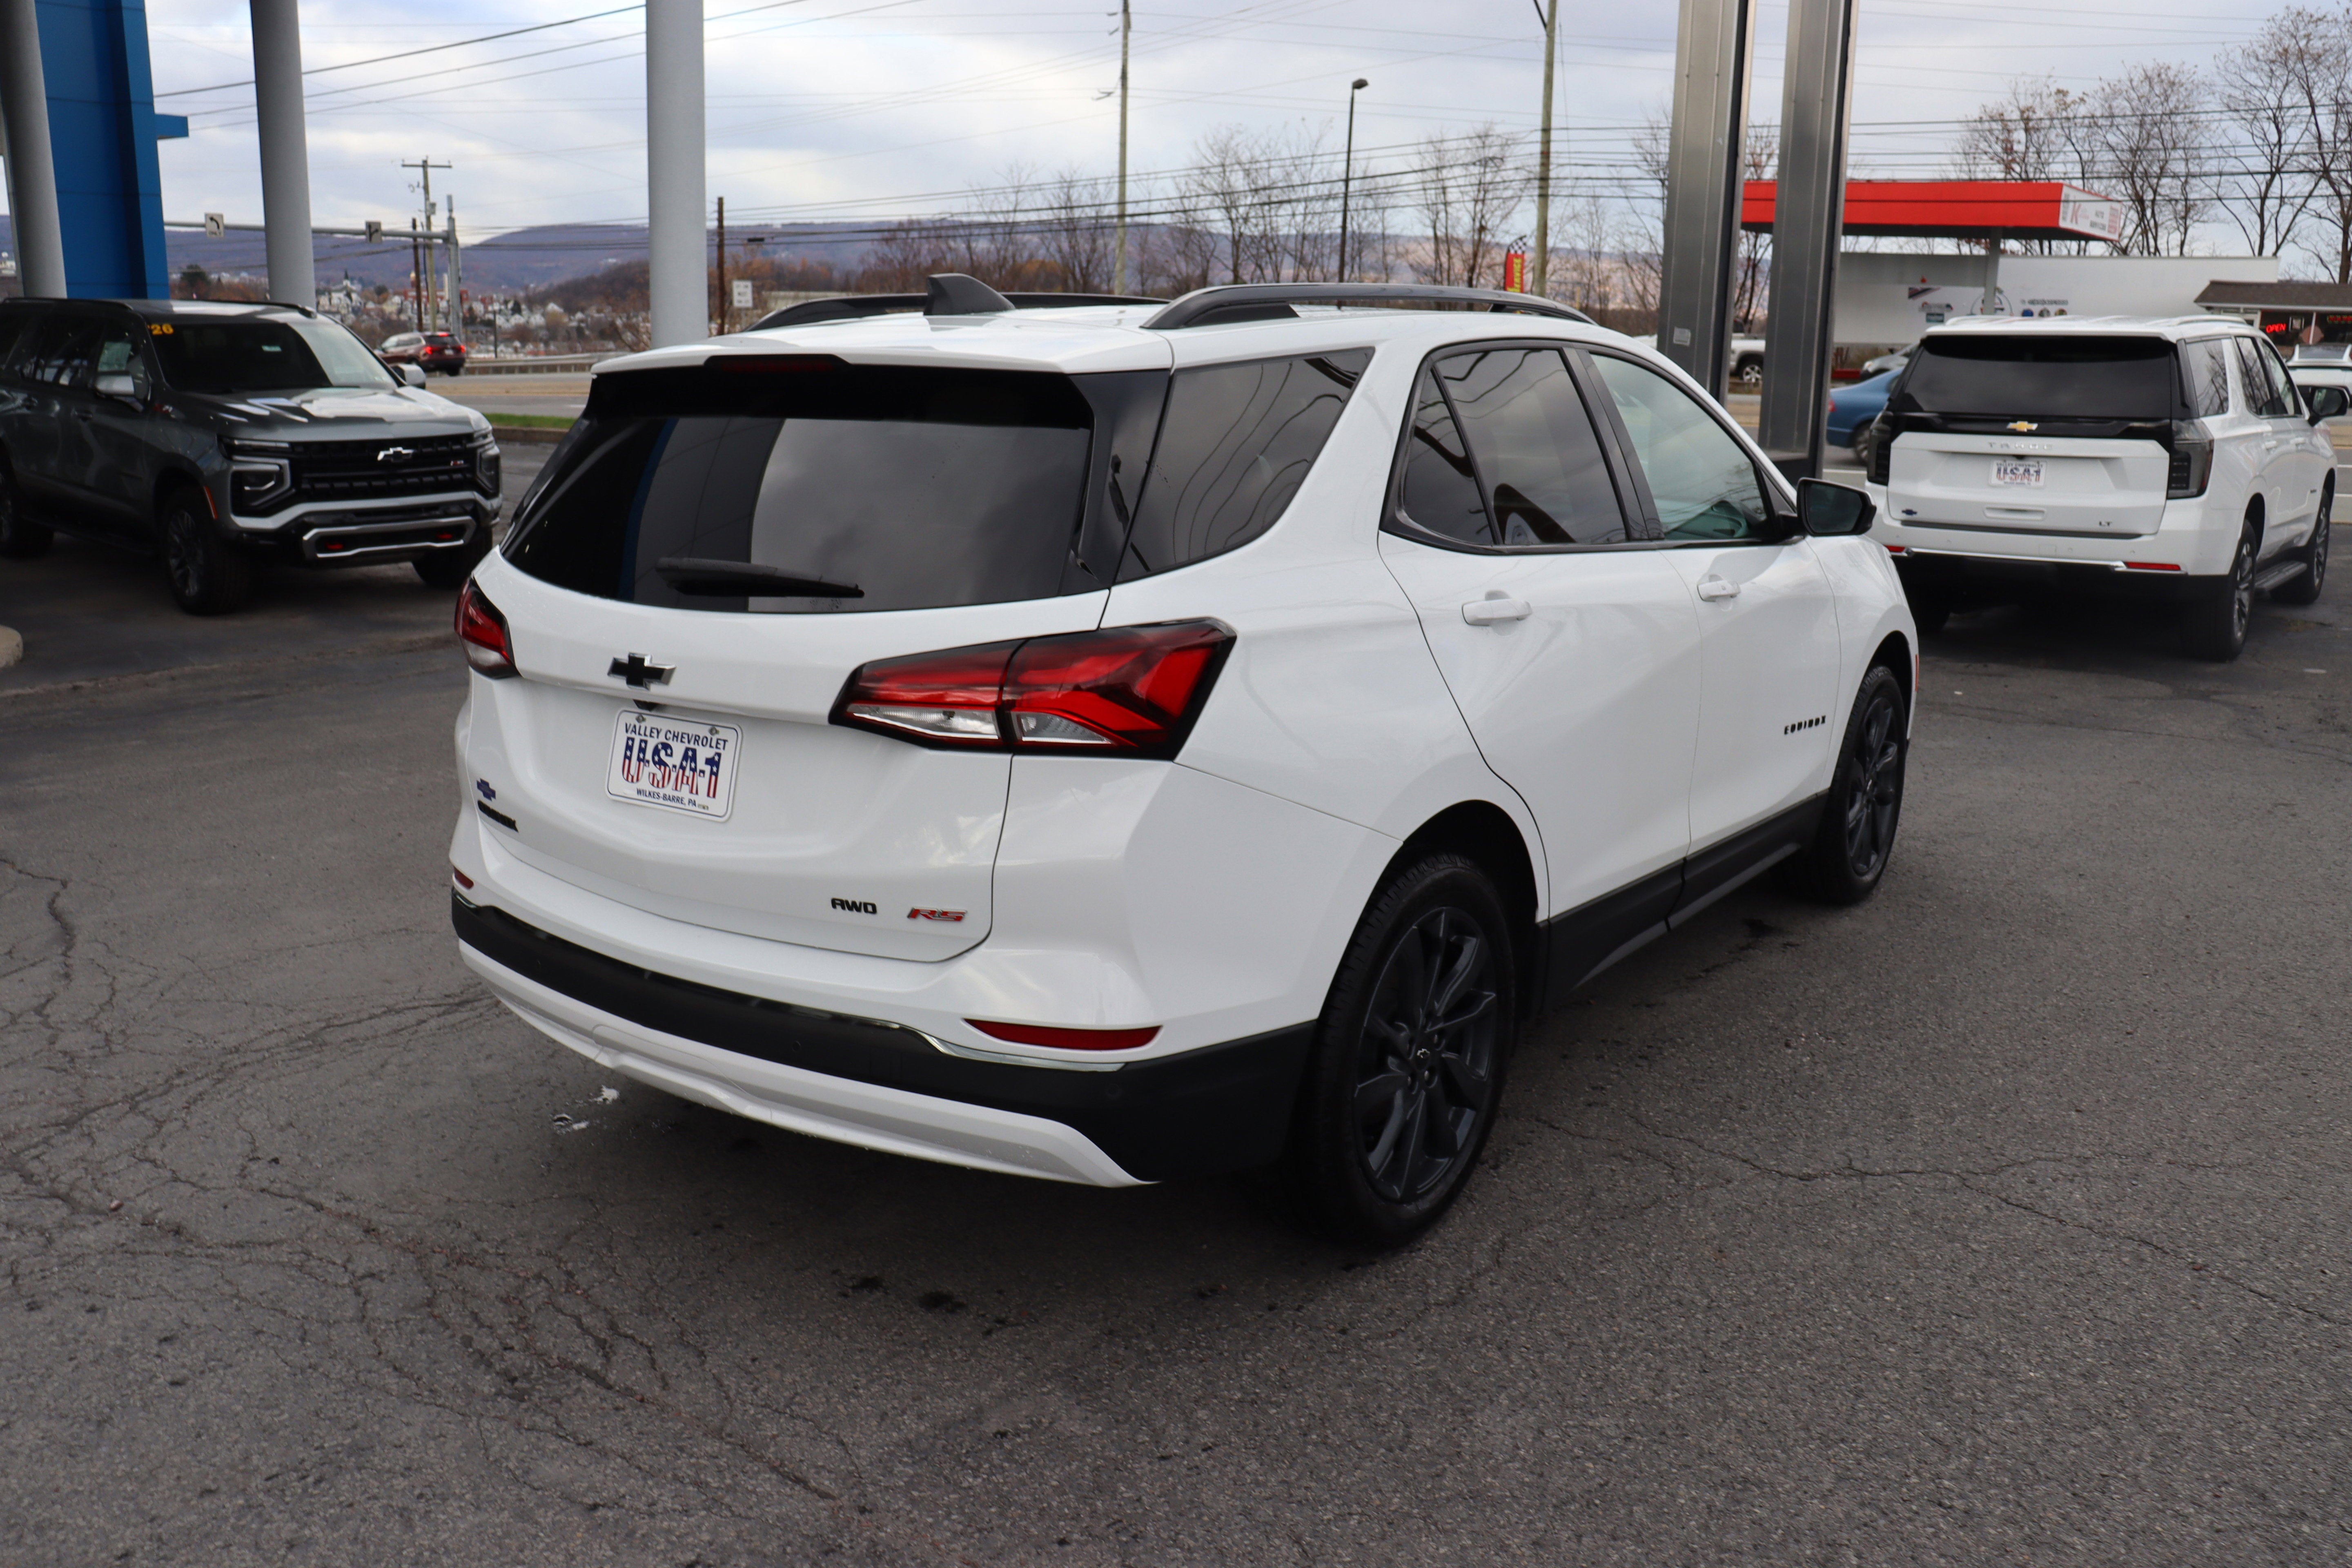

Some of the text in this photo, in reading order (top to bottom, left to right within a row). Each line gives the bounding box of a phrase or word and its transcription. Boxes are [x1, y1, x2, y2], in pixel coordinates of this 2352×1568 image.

[2265, 323, 2287, 334] OPEN
[1784, 715, 1826, 735] EQUINOX
[625, 722, 728, 751] VALLEY CHEVROLET
[636, 788, 686, 804] WILKES-BARRE,
[688, 798, 697, 807] PA
[831, 898, 878, 915] AWD
[906, 906, 968, 922] RS
